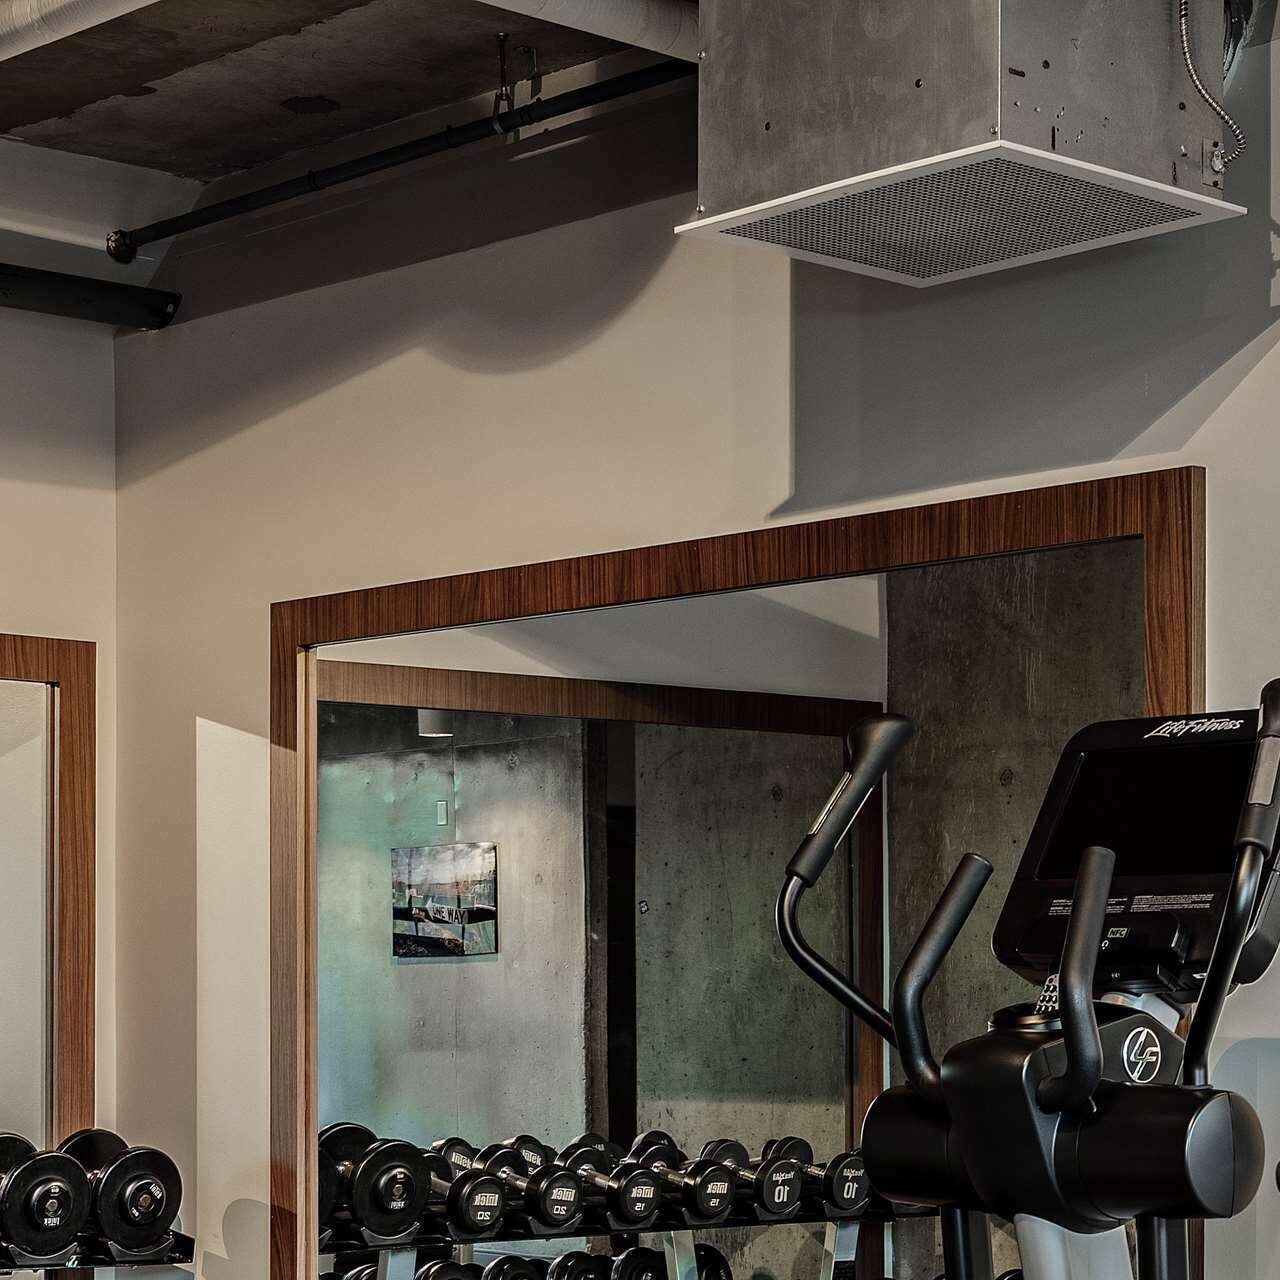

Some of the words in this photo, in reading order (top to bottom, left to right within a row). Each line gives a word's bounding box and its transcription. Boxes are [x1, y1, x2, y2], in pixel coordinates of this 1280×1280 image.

[1144, 719, 1186, 738] Life
[1177, 718, 1244, 737] Fitness
[447, 908, 466, 924] WAY
[1109, 928, 1127, 938] NFC
